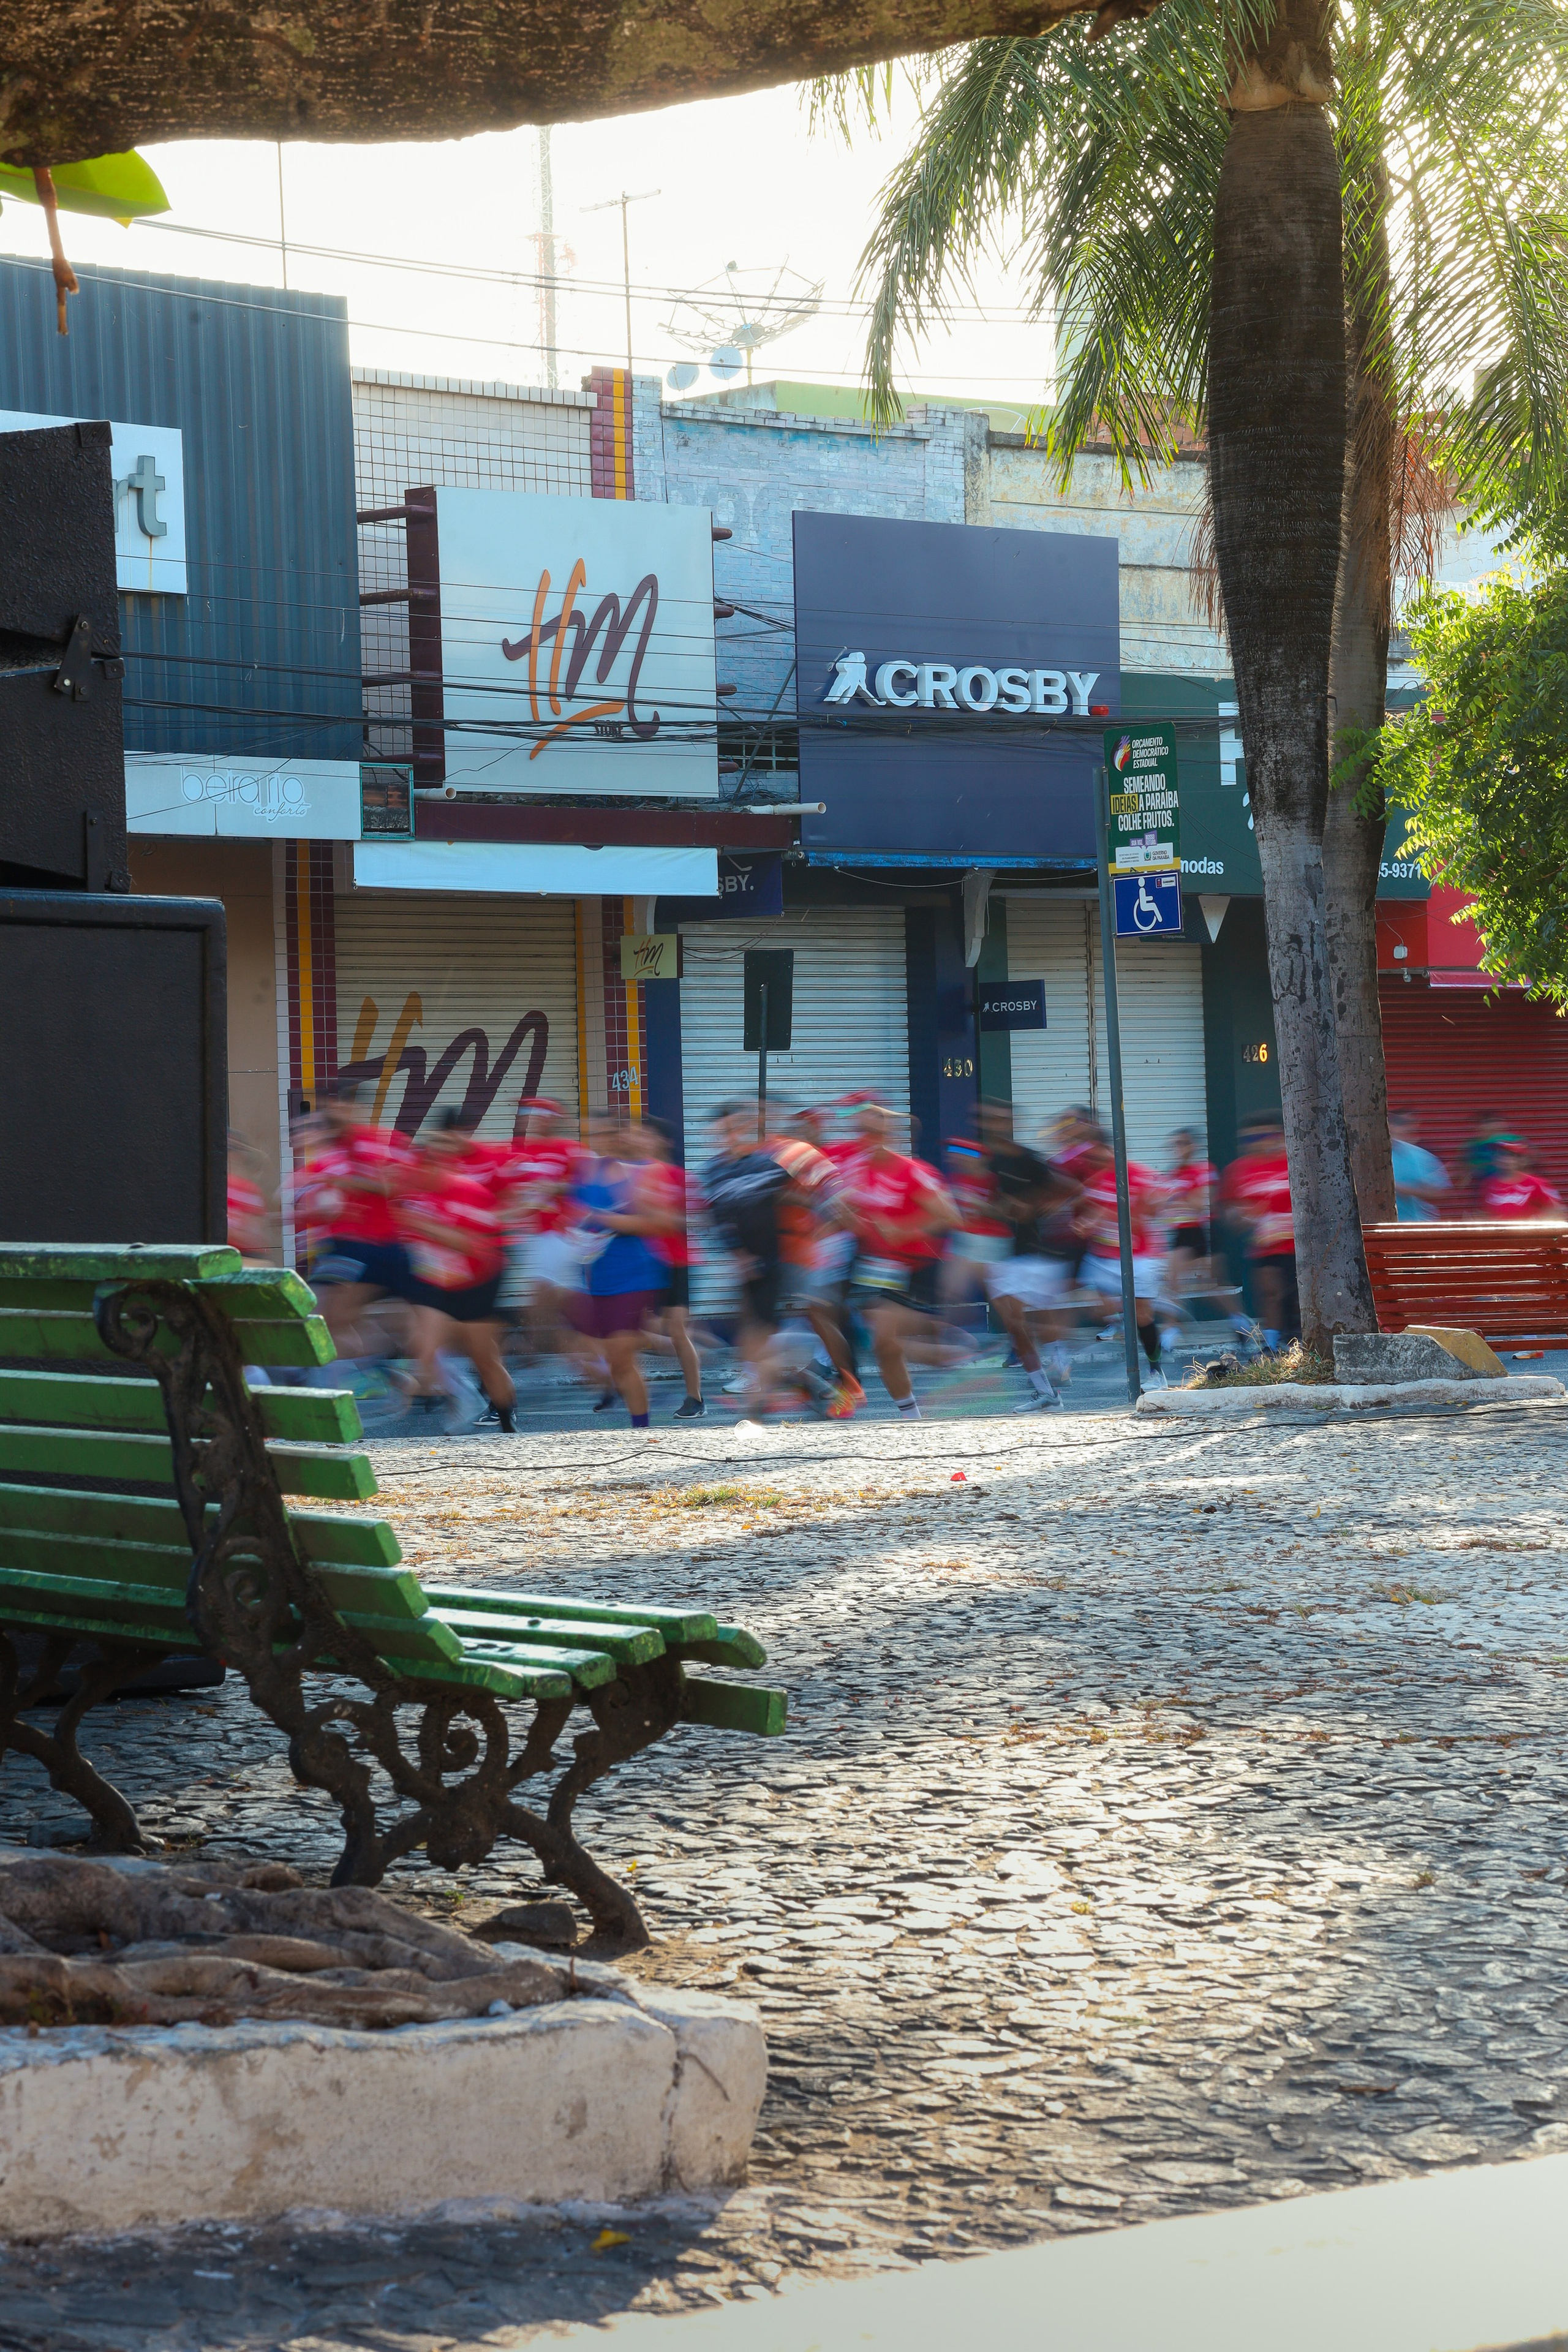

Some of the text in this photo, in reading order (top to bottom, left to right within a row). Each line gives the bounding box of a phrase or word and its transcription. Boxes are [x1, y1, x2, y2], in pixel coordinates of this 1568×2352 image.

[1132, 737, 1163, 749] ORÇAMENTO
[1133, 746, 1169, 759] DEMOCRÁTICO
[1133, 758, 1158, 769] ESTADUAL
[1123, 773, 1166, 794] SEMEANDO
[1139, 794, 1145, 812] A
[1145, 789, 1179, 810] PARAÍBA
[254, 801, 312, 821] conforto
[1118, 810, 1175, 832] COLHE FRUTOS.
[1379, 862, 1422, 880] 5-9371
[1243, 1043, 1268, 1063] 426
[943, 1058, 973, 1077] 430
[612, 1066, 639, 1091] 434
